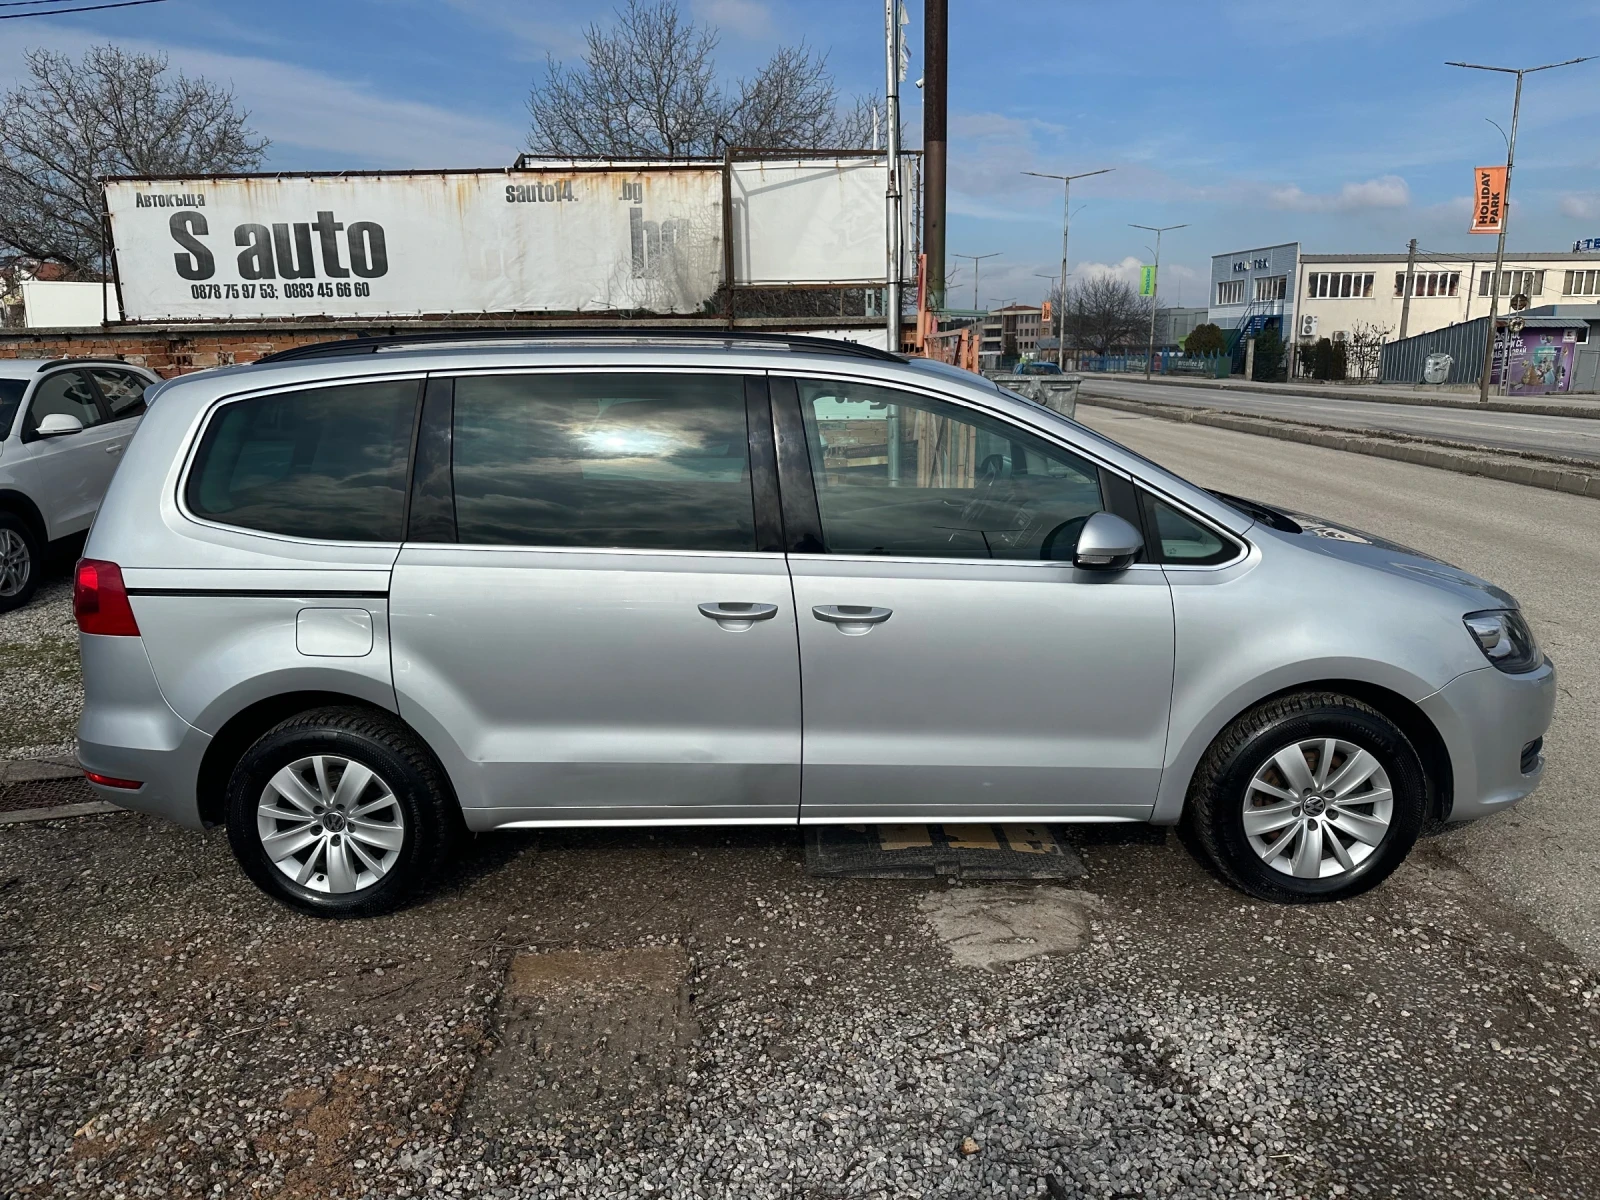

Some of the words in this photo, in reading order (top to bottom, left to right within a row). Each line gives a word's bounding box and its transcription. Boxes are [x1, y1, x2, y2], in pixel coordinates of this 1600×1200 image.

[136, 192, 206, 208] Автокъща
[505, 180, 579, 203] sauto14.
[1478, 171, 1491, 224] HOLIDAY
[1489, 191, 1500, 224] PARK
[169, 210, 216, 281] S
[233, 210, 389, 281] auto
[190, 283, 221, 299] 0878
[224, 283, 239, 299] 75
[241, 283, 256, 299] 97
[259, 283, 279, 300] 53;
[284, 283, 314, 298] 0883
[317, 283, 333, 298] 45
[335, 283, 351, 298] 66
[353, 282, 370, 297] 60
